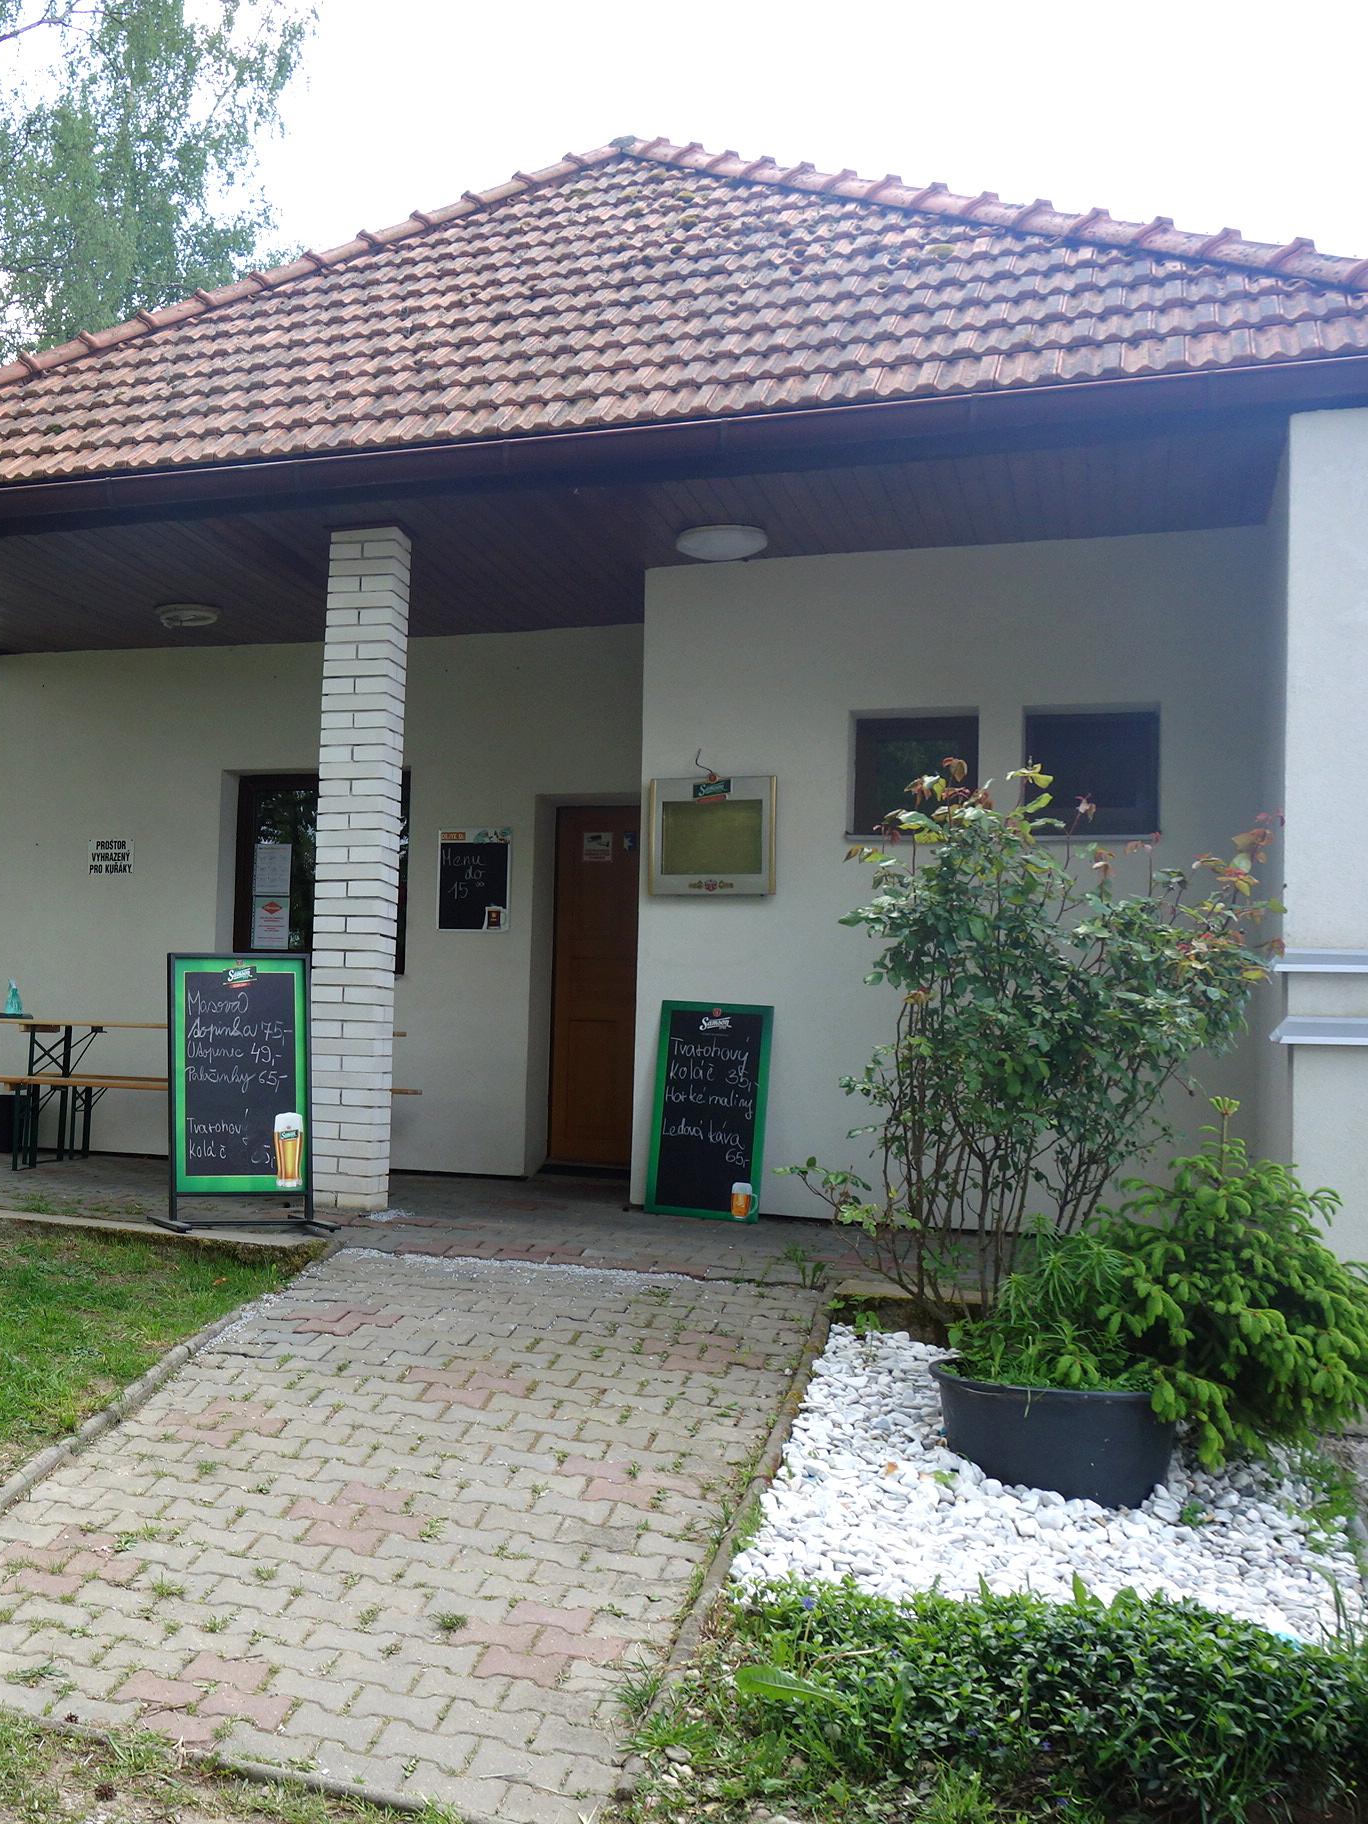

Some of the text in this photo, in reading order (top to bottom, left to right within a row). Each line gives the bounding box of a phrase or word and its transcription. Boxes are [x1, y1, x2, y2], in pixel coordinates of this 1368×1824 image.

[96, 840, 126, 850] PROSTOR
[91, 850, 130, 862] VYHRAZENÝ
[442, 847, 487, 866] Menu
[89, 862, 132, 874] PRO KUŘÁKY
[464, 866, 486, 880] do
[447, 881, 469, 900] 15
[670, 1036, 750, 1075] Tvarohový
[709, 1089, 754, 1120] maliny
[662, 1117, 704, 1140] Ledová
